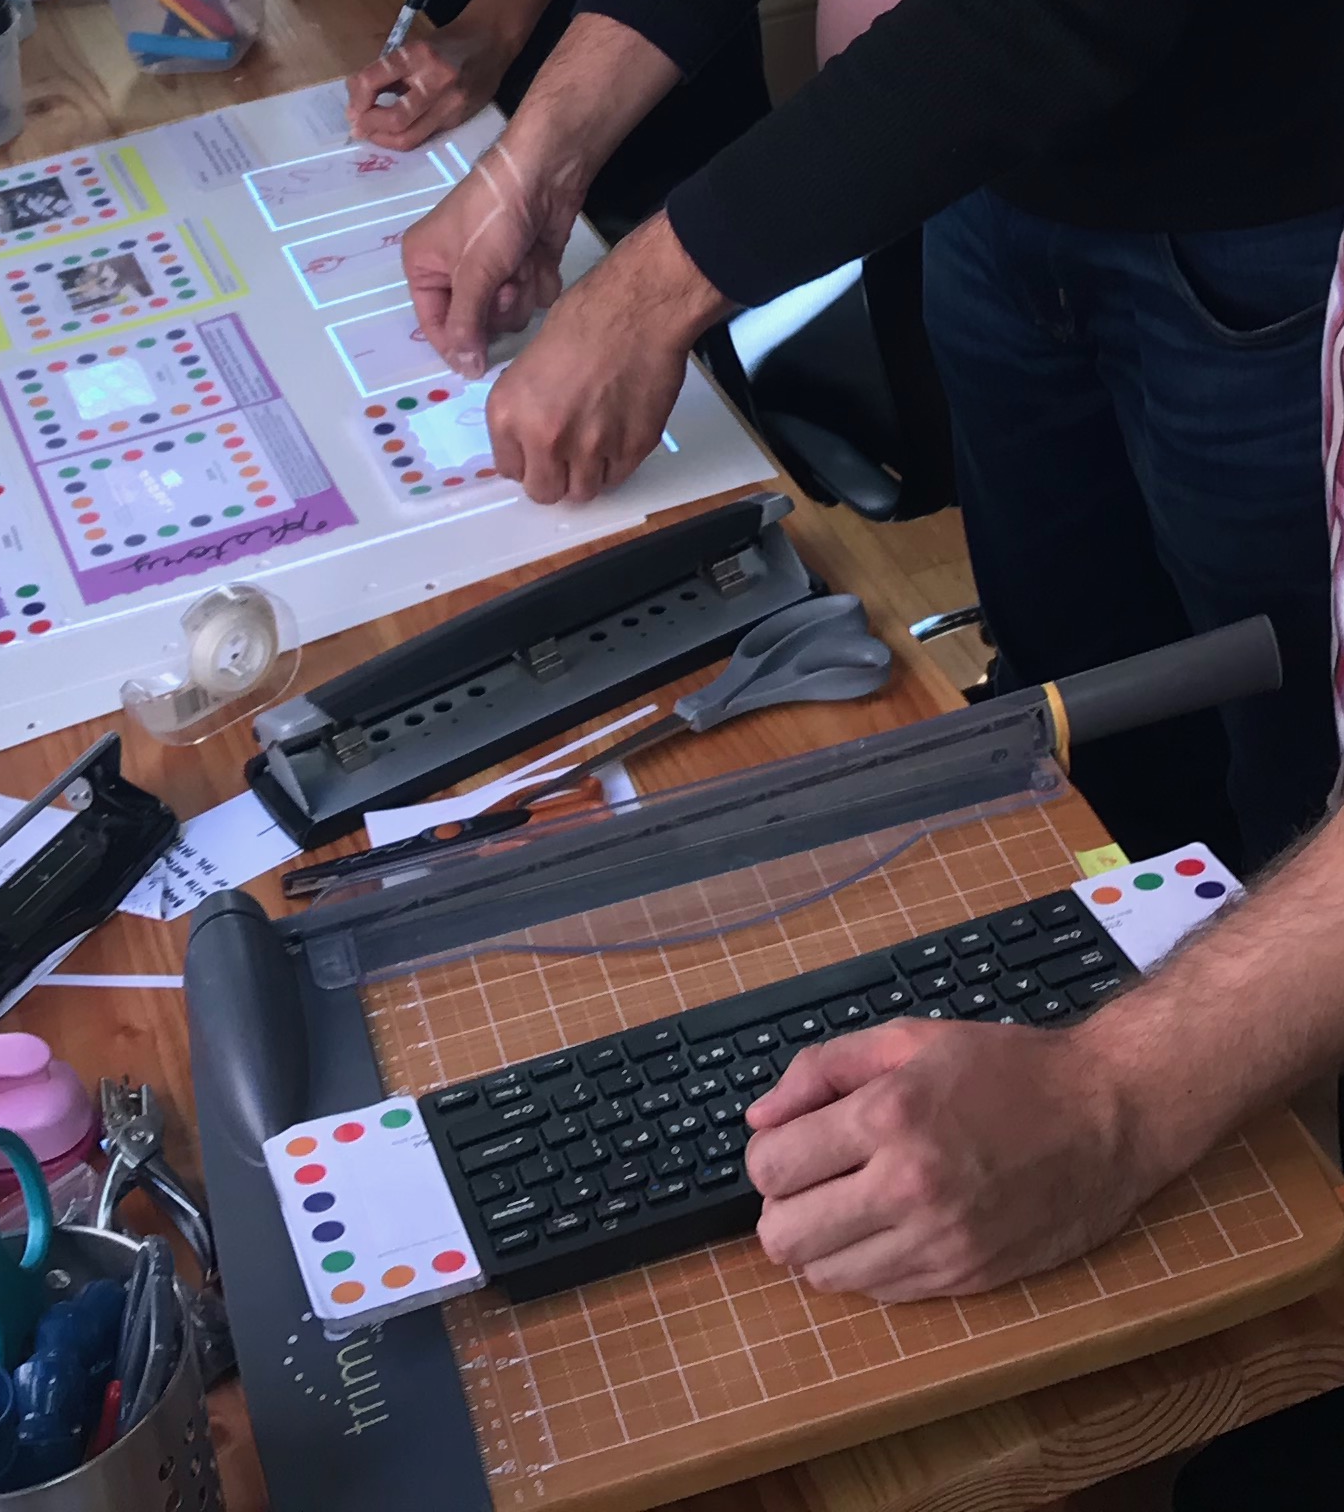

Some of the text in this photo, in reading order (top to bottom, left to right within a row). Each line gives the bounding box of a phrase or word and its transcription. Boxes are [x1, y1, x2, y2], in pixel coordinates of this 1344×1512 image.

[110, 510, 328, 575] History
[977, 962, 991, 973] Z
[933, 976, 947, 987] X
[1016, 978, 1028, 989] A
[848, 1006, 859, 1016] V
